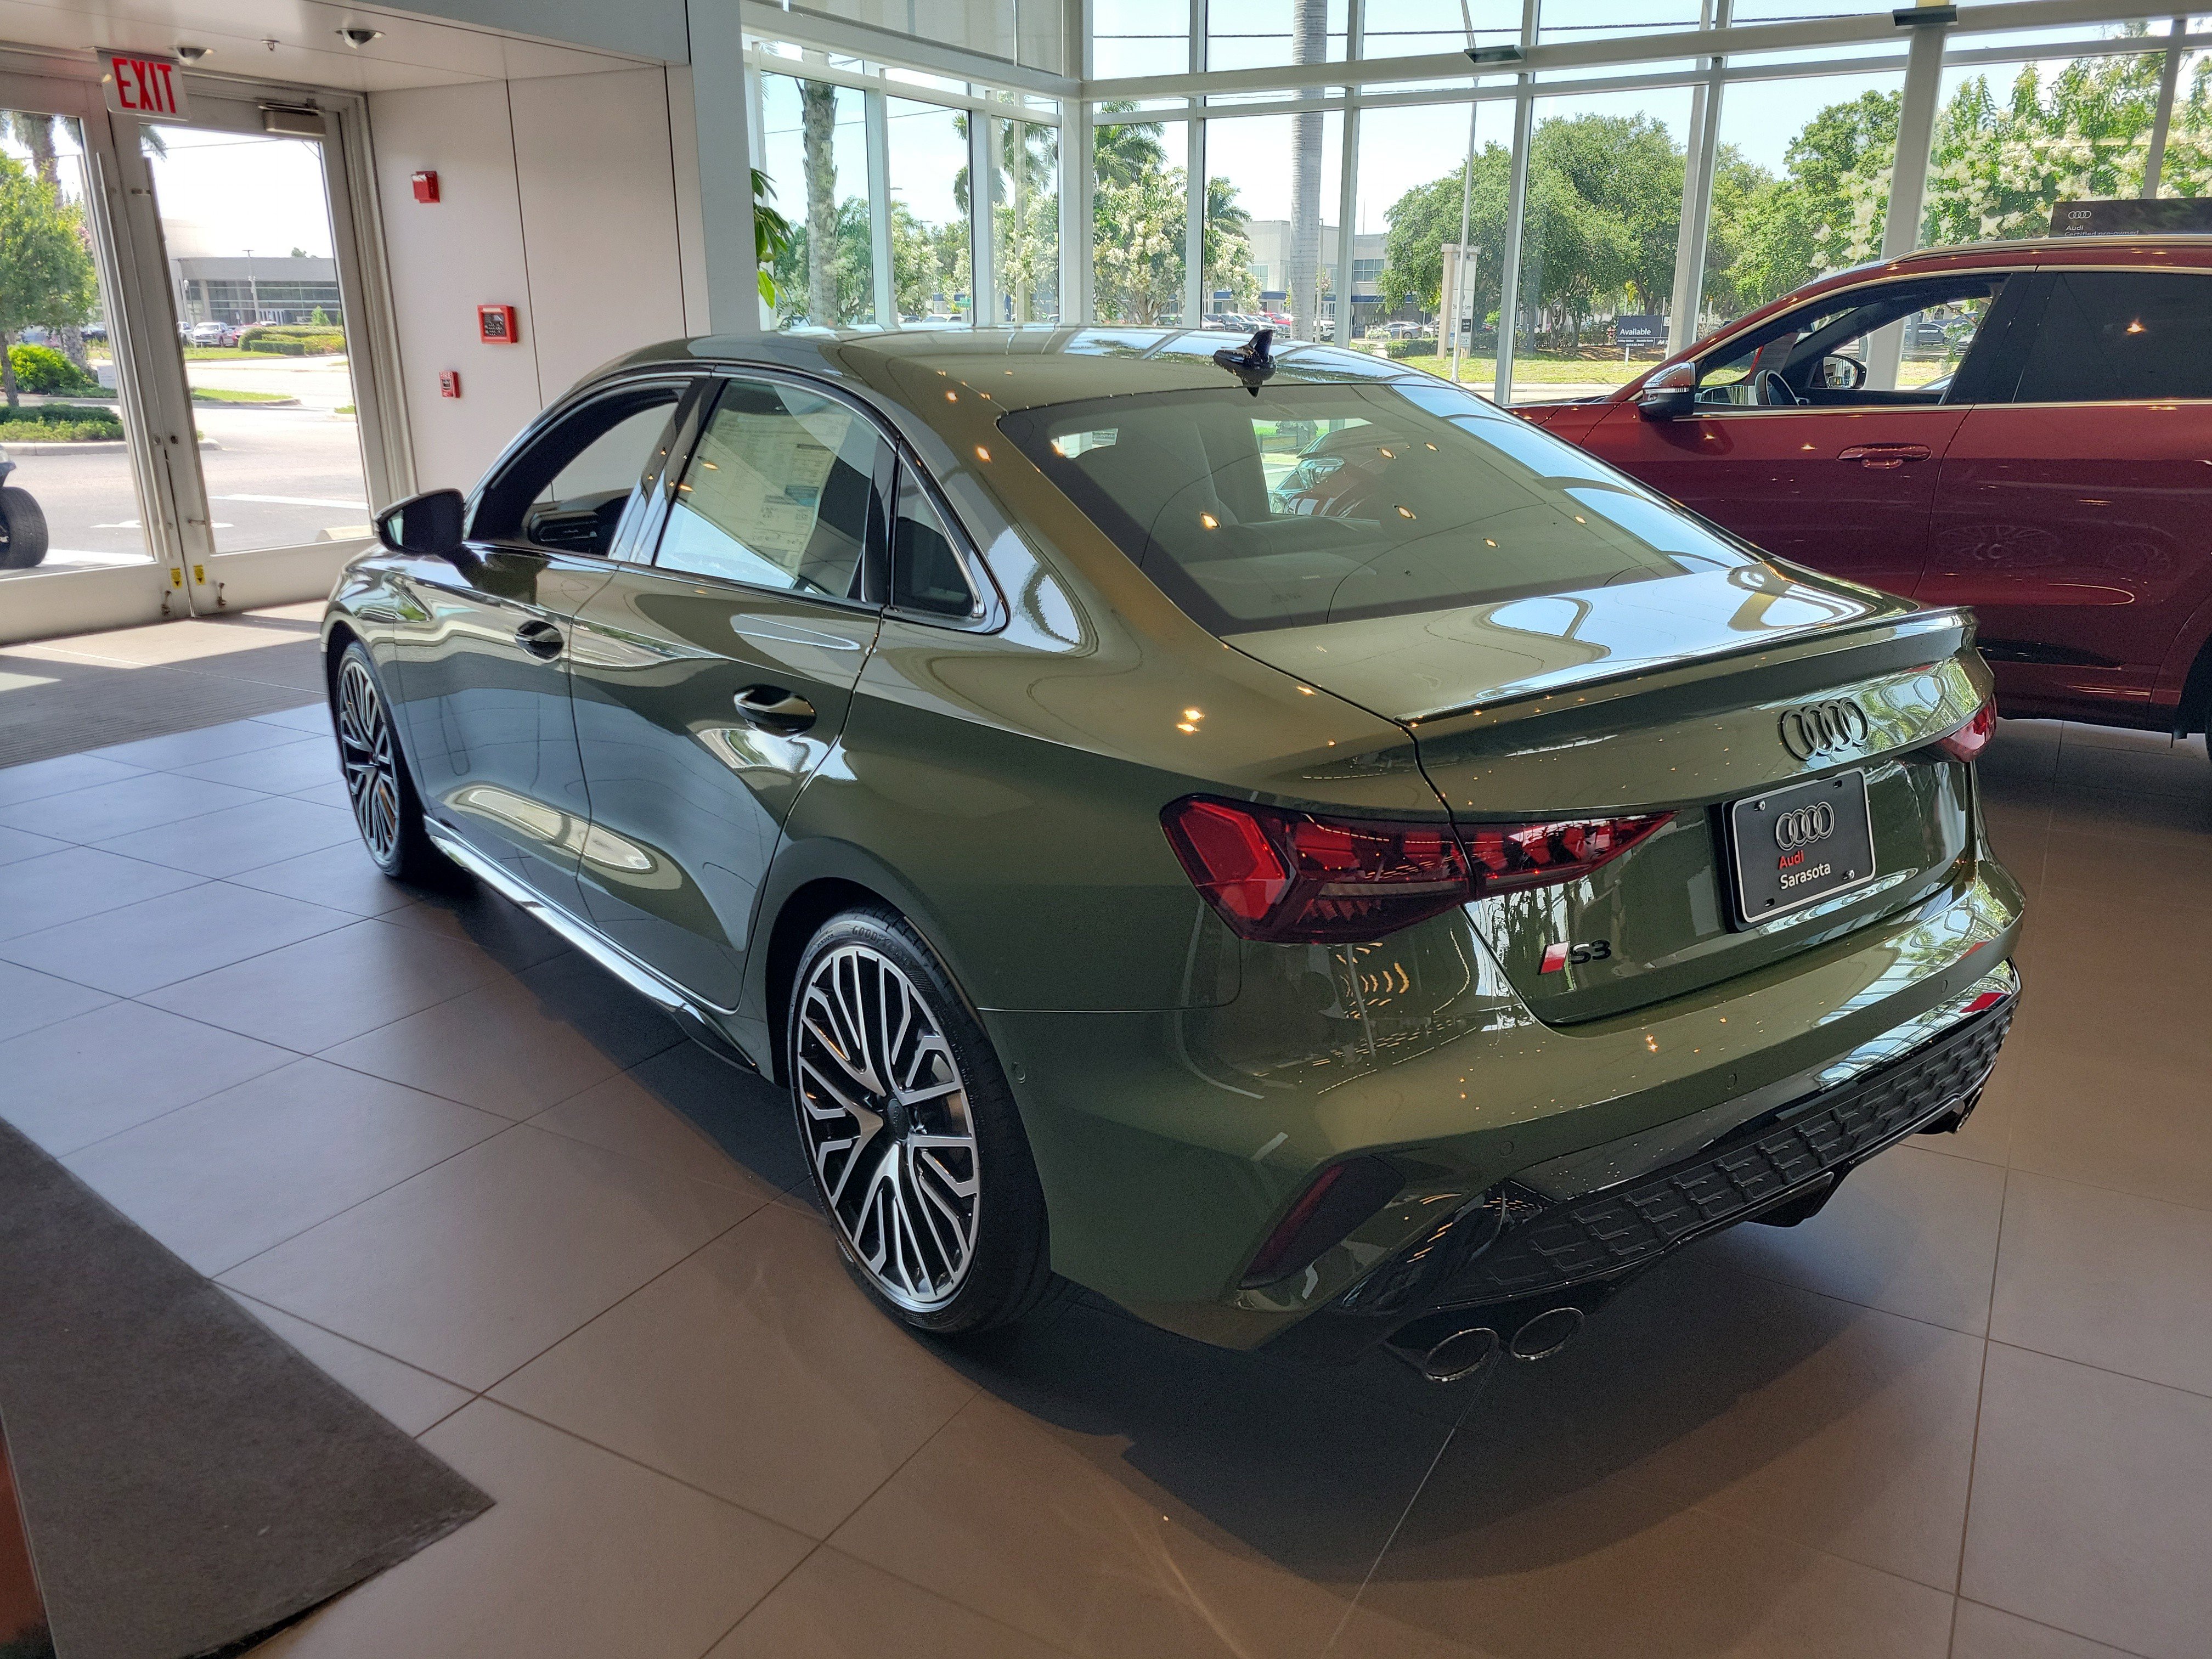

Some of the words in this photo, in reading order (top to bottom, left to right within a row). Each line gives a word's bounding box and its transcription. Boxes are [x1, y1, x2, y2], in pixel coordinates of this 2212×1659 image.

[111, 57, 176, 114] EXIT
[1778, 850, 1805, 870] Audi
[1780, 863, 1831, 890] Sarasota
[1570, 939, 1612, 965] S3
